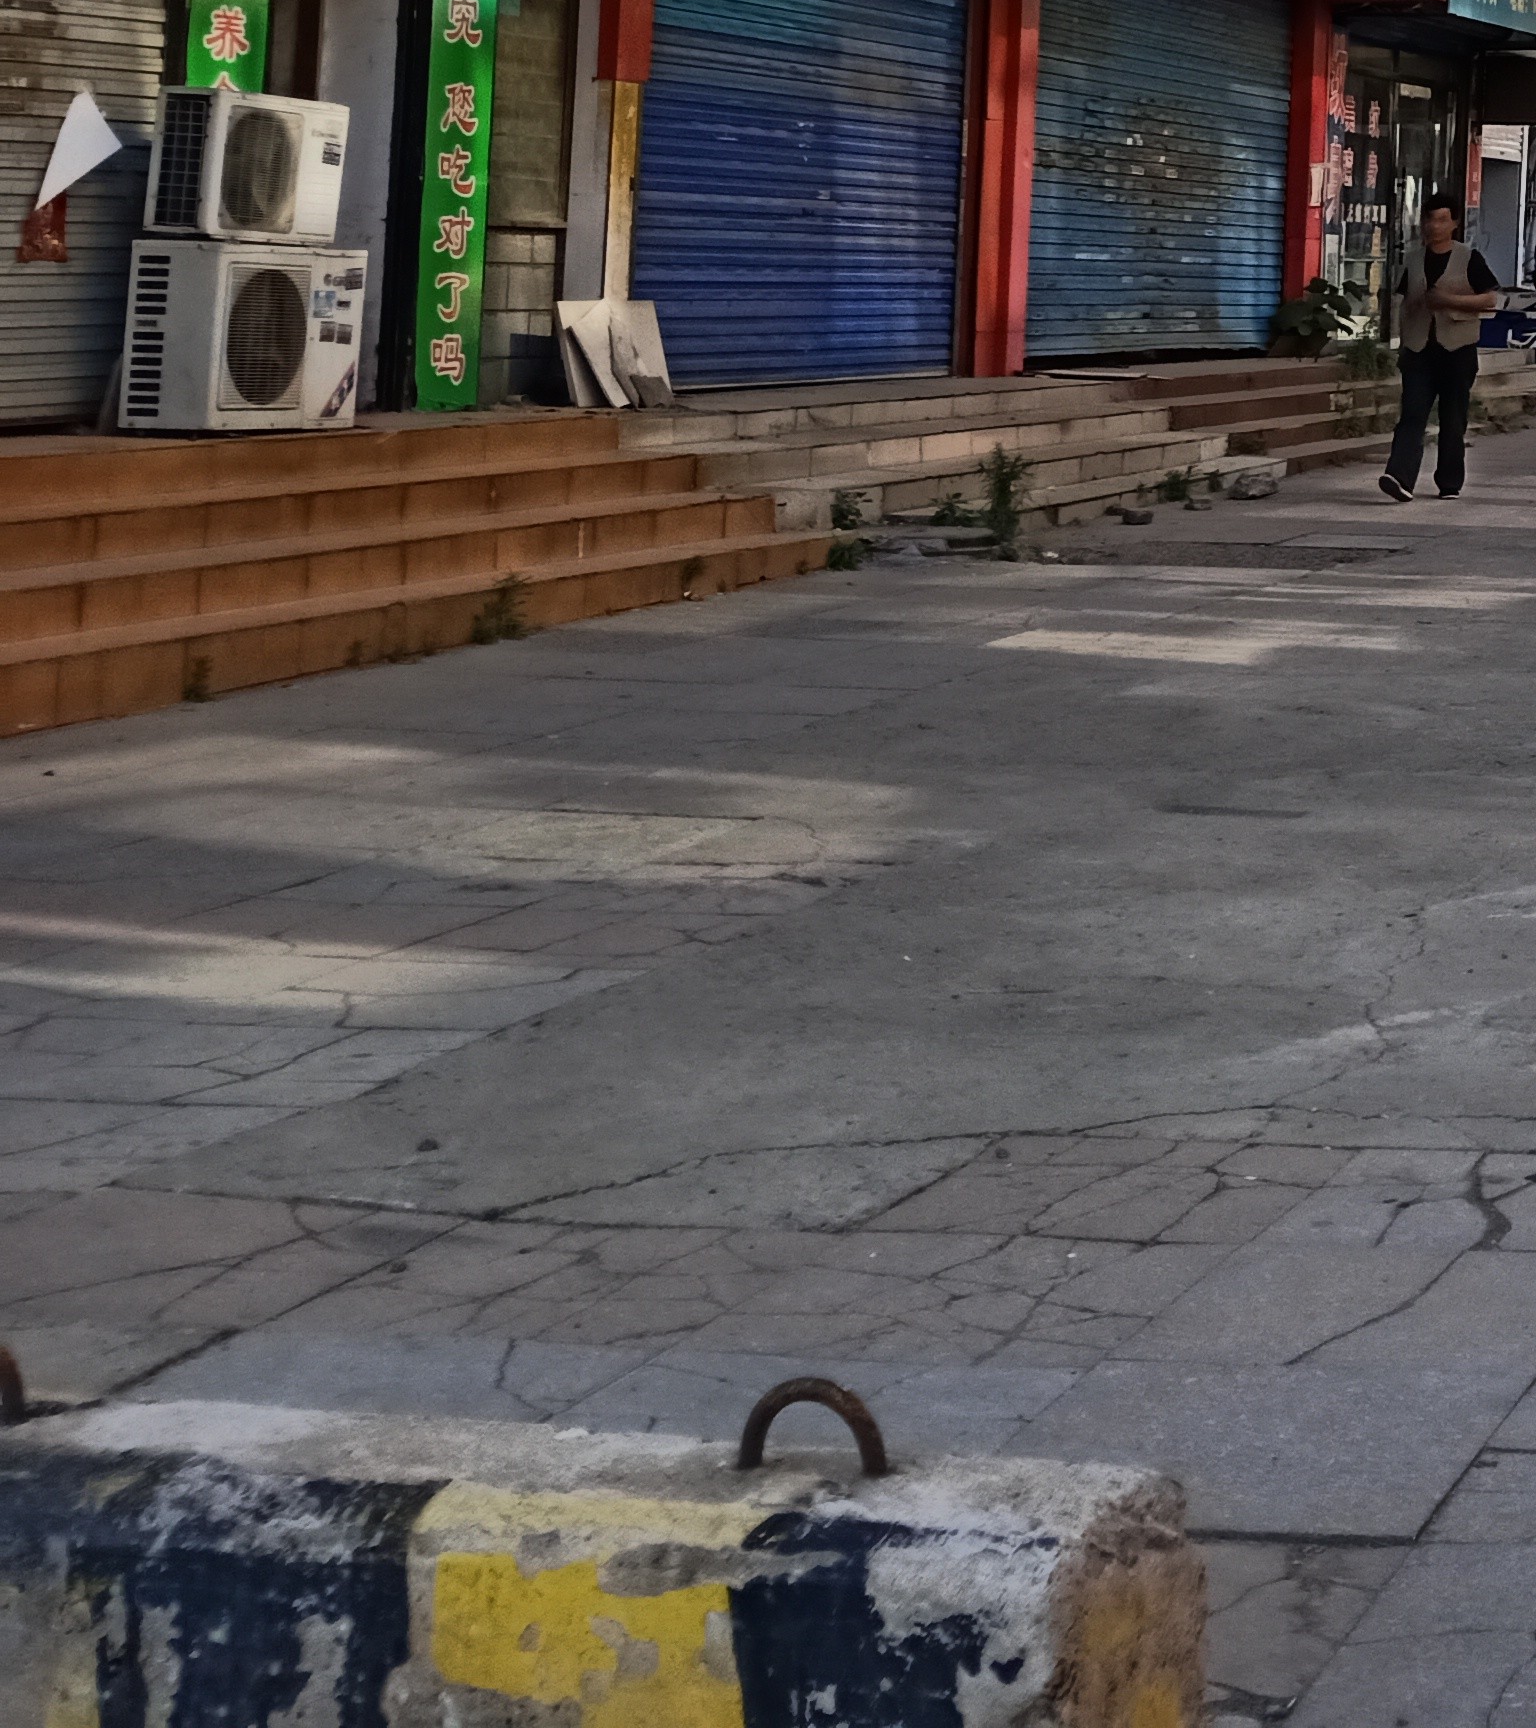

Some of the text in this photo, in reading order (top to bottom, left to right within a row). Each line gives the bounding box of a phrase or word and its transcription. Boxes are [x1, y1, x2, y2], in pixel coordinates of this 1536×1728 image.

[429, 84, 478, 384] 您吃对了吗
